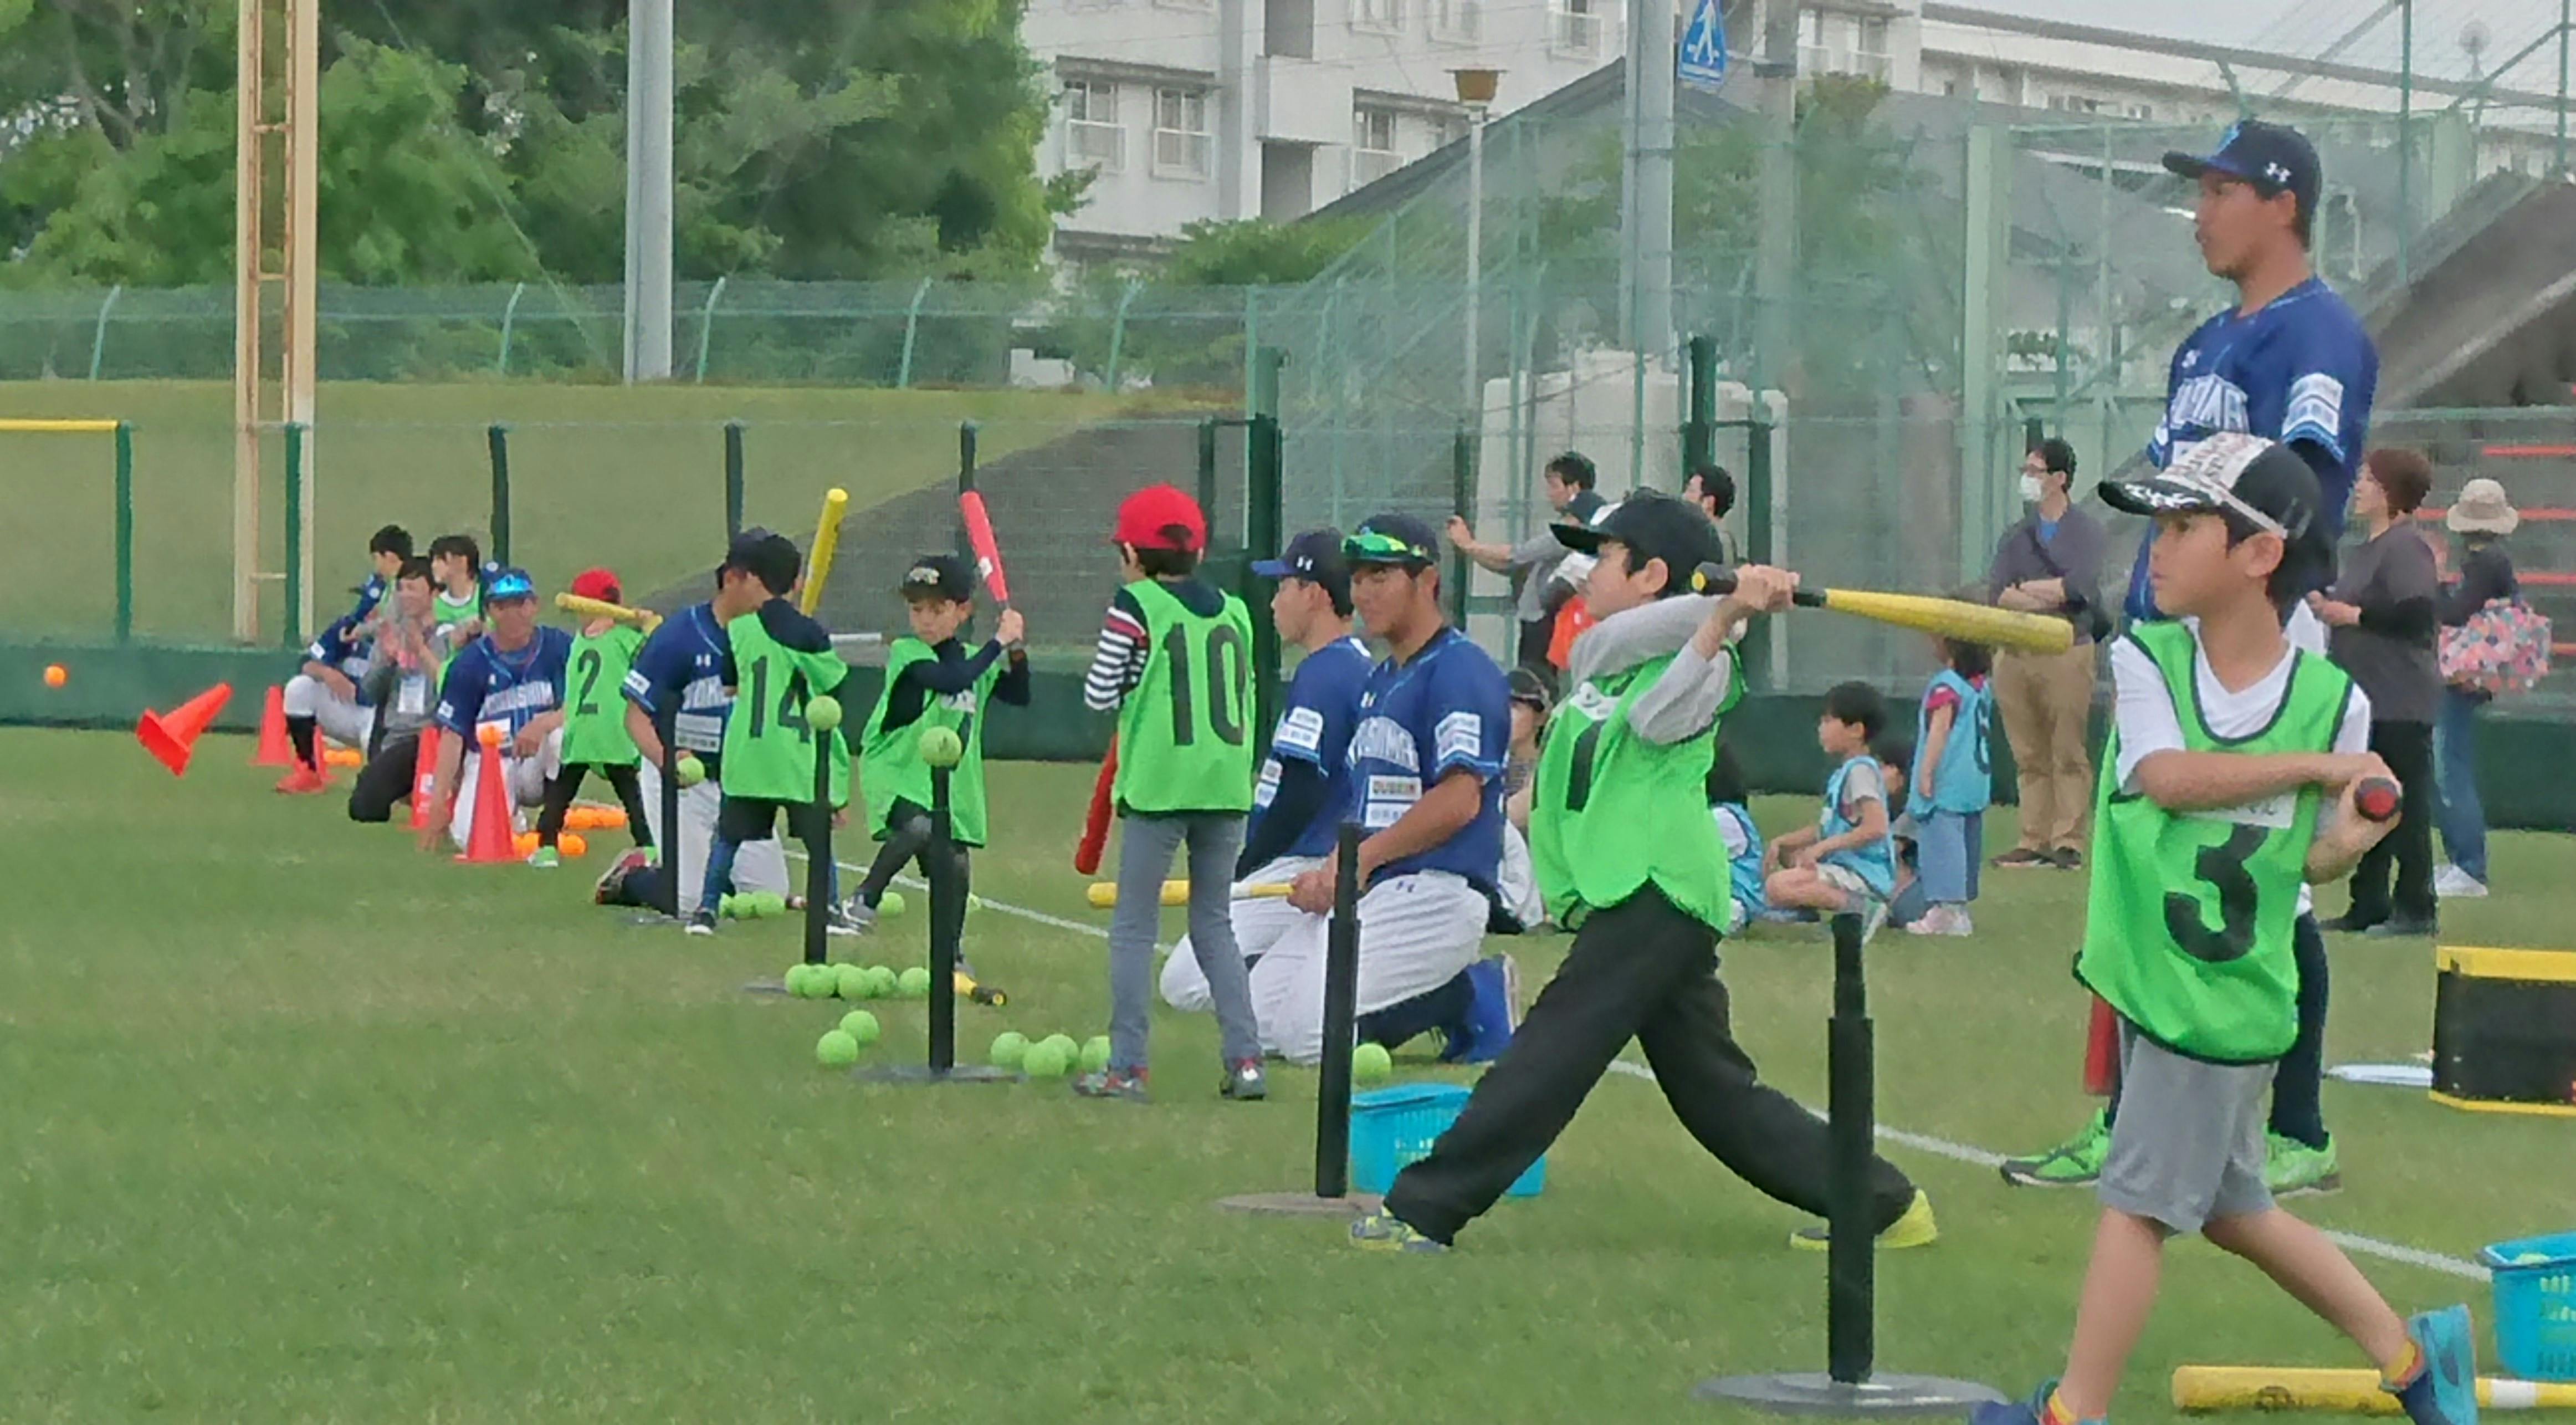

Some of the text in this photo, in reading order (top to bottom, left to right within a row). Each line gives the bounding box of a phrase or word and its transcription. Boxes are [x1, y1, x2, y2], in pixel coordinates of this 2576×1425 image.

[575, 648, 602, 717] 2
[750, 656, 810, 744] 14
[1163, 621, 1246, 747] 10
[2164, 823, 2269, 963] 3
